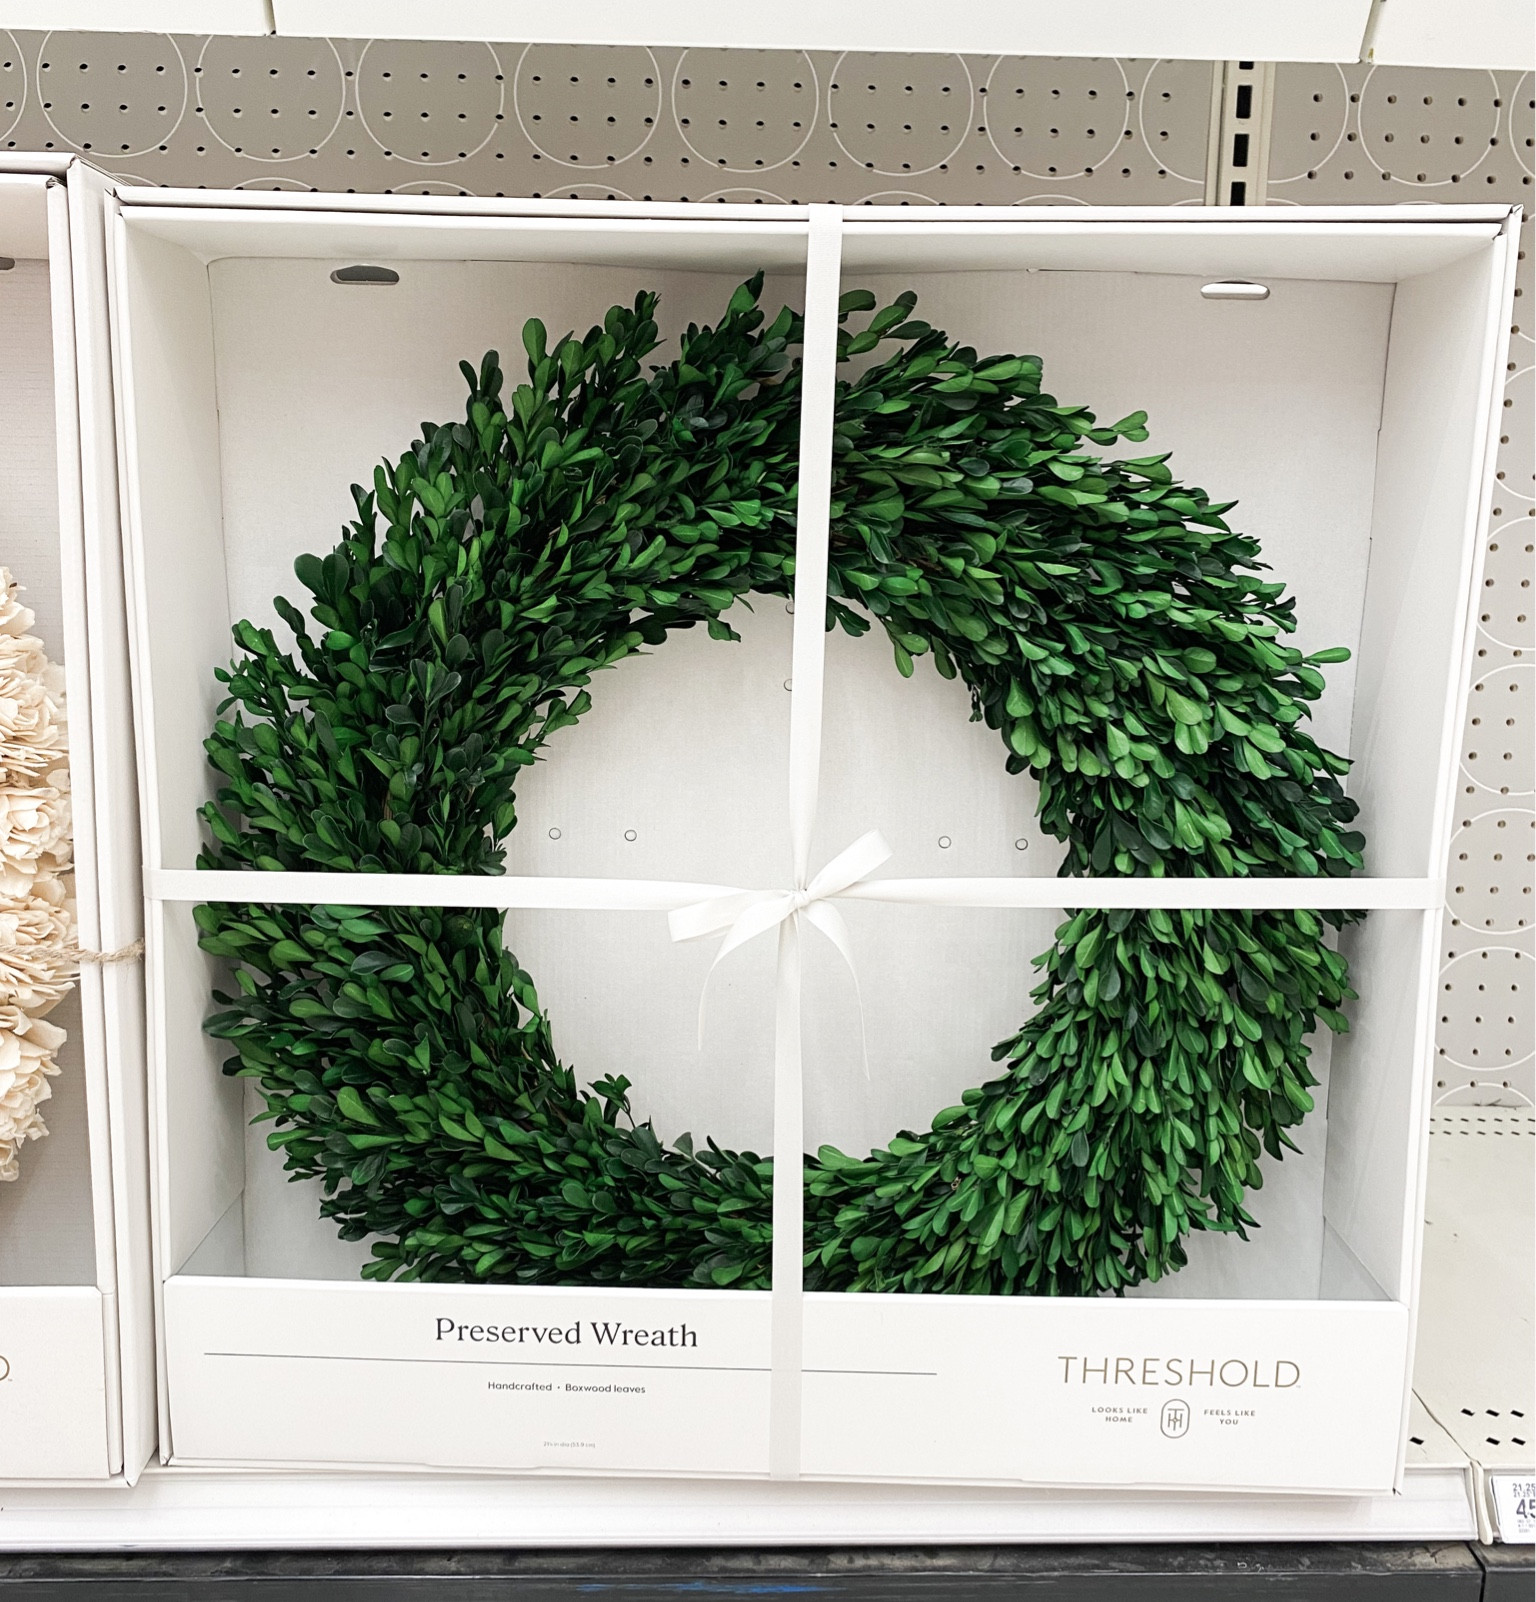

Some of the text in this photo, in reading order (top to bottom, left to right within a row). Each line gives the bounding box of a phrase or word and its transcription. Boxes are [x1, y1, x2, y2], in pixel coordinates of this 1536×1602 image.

[435, 1316, 698, 1348] Preserved Wreath
[1057, 1355, 1301, 1388] THRESHOLD
[487, 1381, 646, 1394] Handcrafted Boxwood leaves
[1091, 1406, 1148, 1415] LOOKS LIKE
[1234, 1409, 1256, 1417] LIKE
[1105, 1415, 1133, 1423] HOME
[1219, 1418, 1239, 1426] YOU
